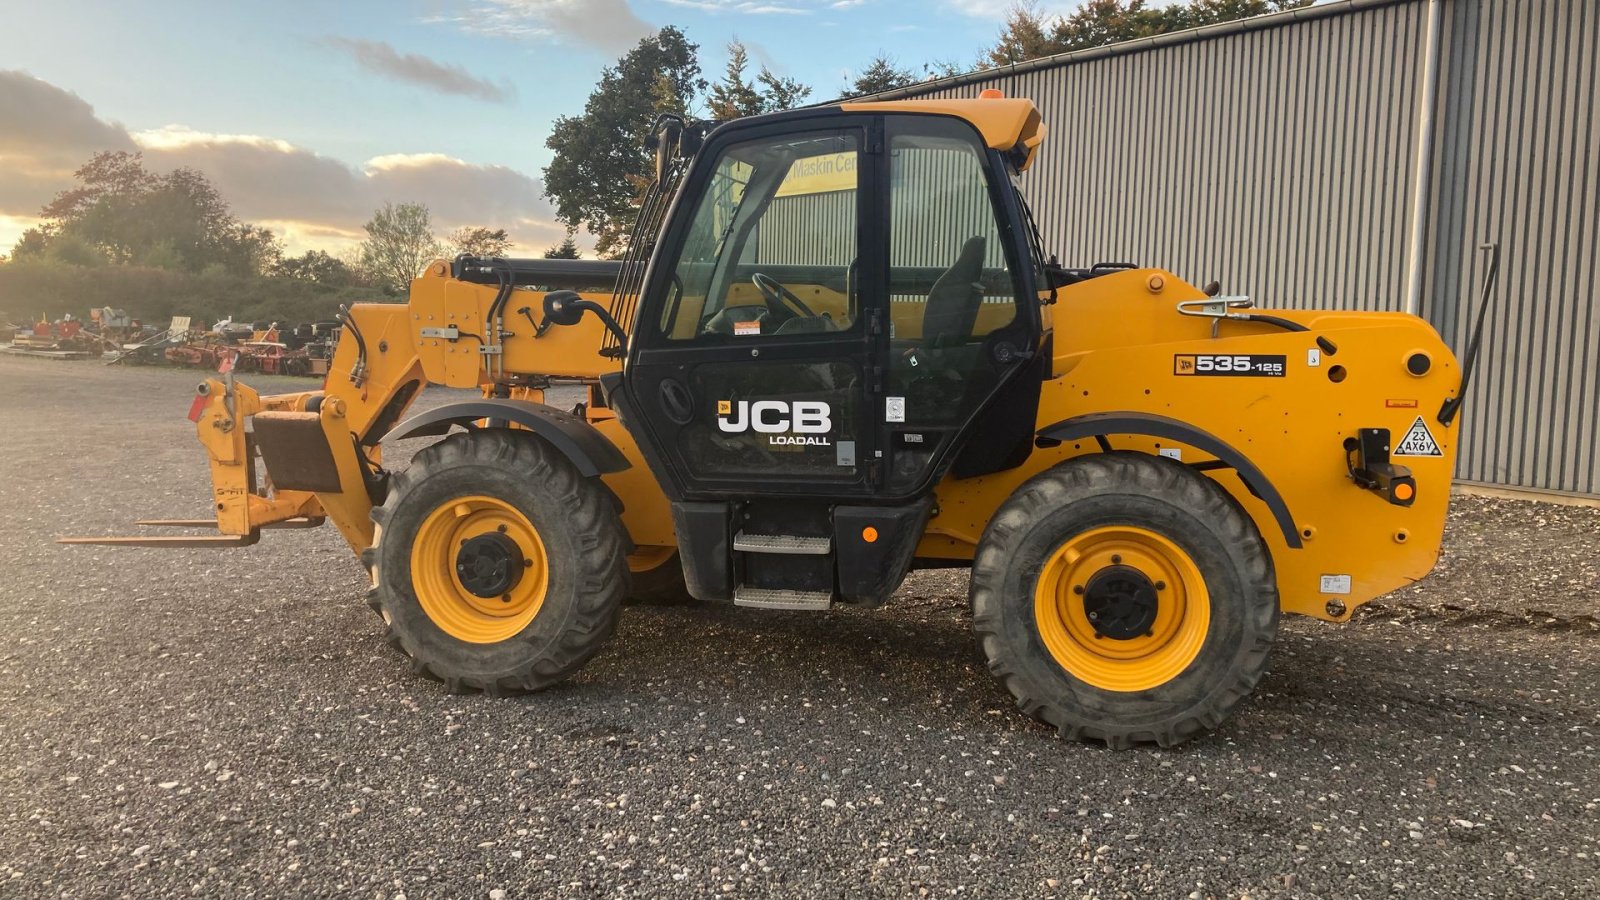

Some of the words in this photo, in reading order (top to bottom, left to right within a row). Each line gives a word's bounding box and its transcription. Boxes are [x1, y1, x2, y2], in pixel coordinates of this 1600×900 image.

[793, 157, 833, 178] Maskin
[718, 400, 832, 433] JCB
[769, 436, 831, 446] LOADALL
[1412, 431, 1426, 441] 23
[1405, 441, 1432, 451] AX6V
